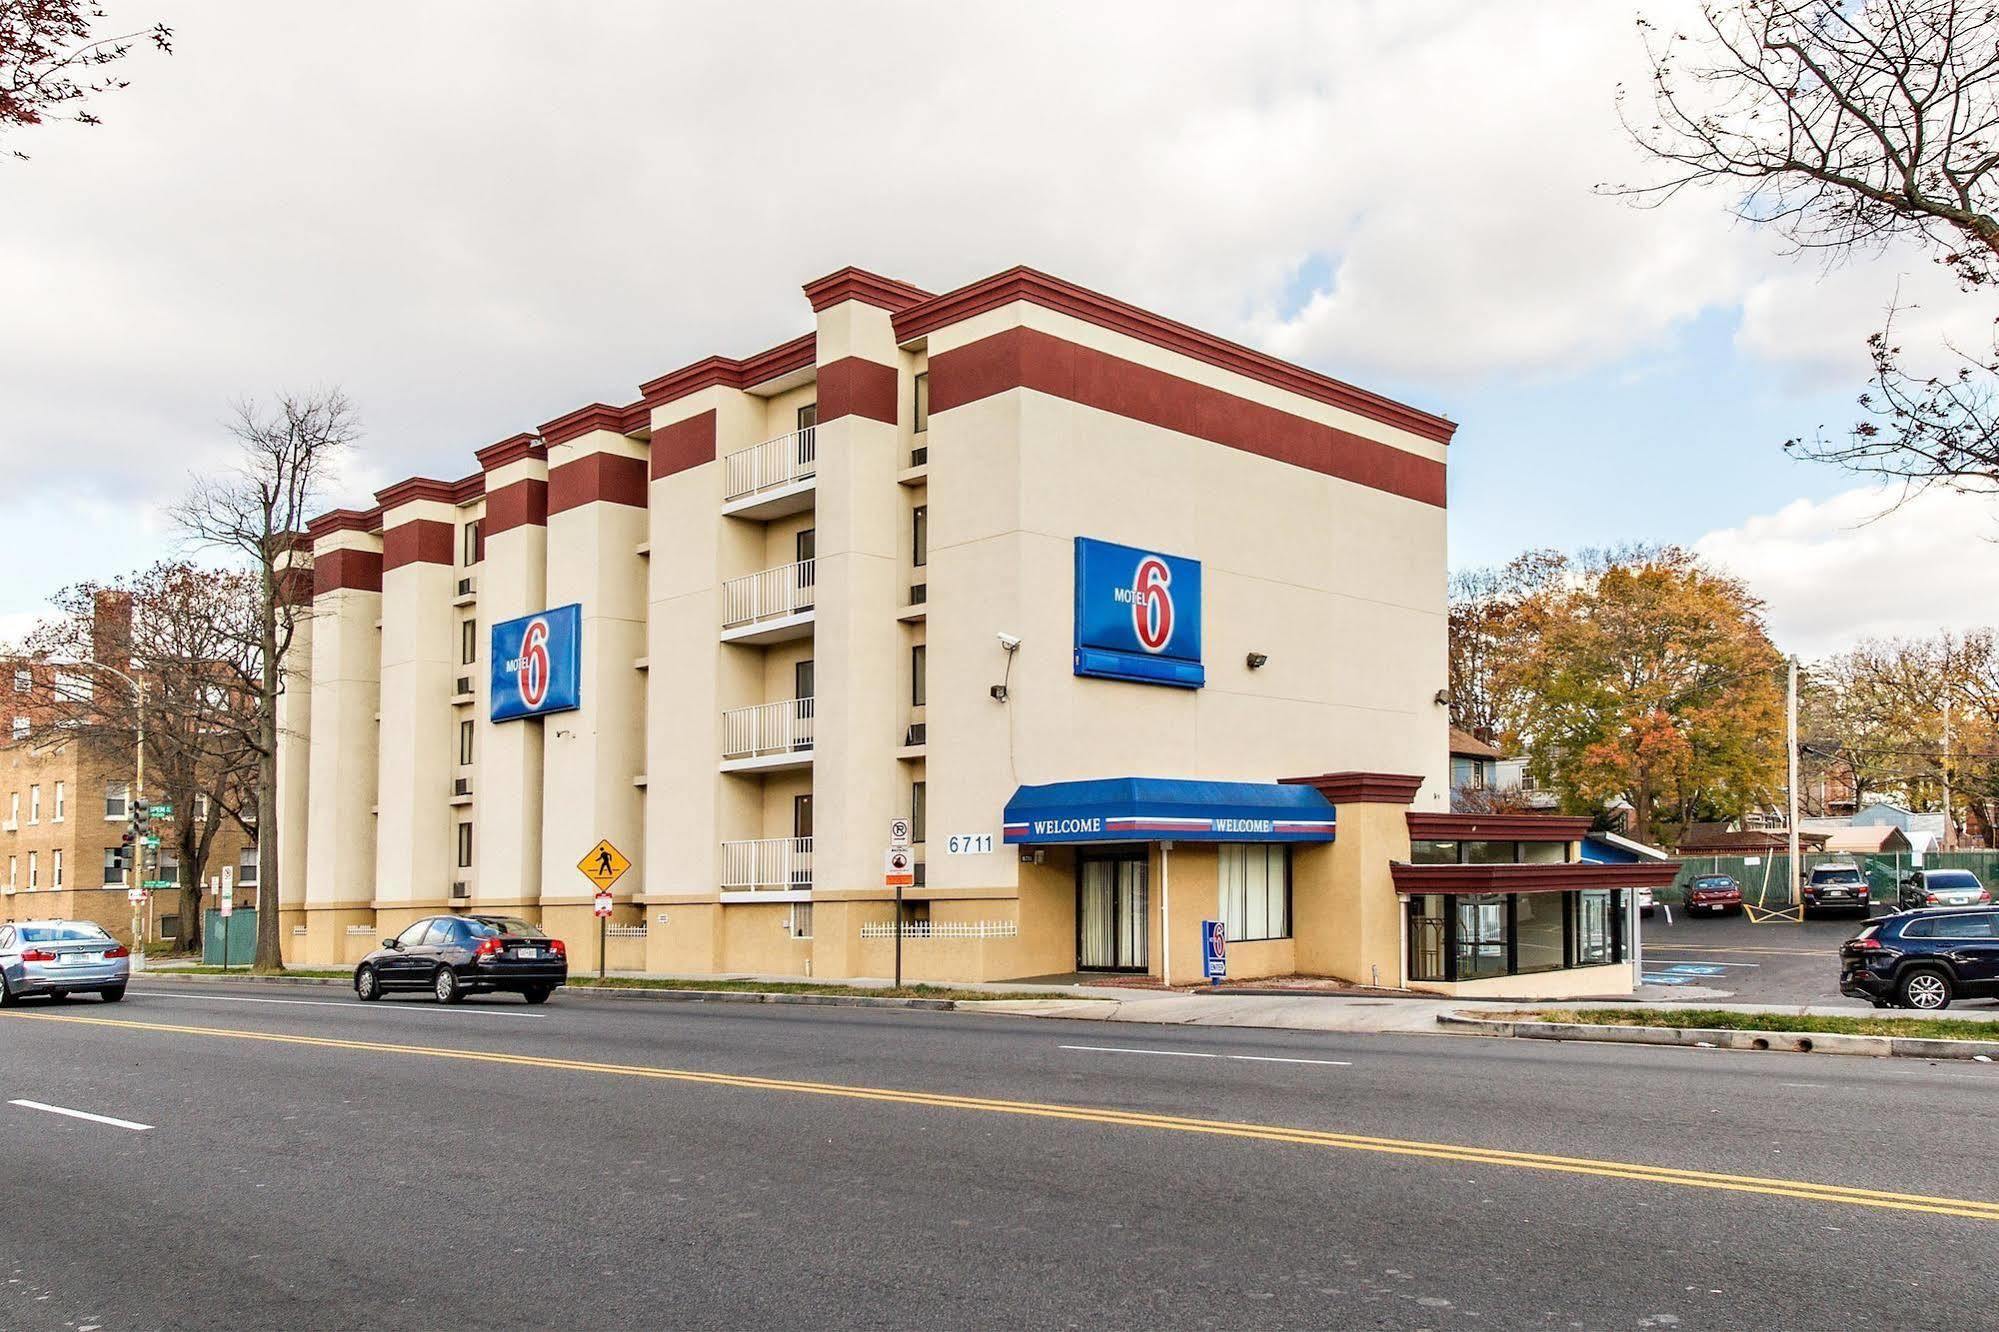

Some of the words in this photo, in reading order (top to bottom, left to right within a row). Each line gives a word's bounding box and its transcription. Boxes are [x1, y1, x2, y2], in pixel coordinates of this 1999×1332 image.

[1114, 587, 1148, 607] MOTEL
[1132, 557, 1173, 652] 6
[506, 656, 530, 673] MOTEL
[519, 619, 549, 708] 6
[1034, 818, 1101, 835] WELCOME
[1216, 819, 1270, 832] WELCOME
[949, 835, 991, 853] 6711
[1213, 922, 1225, 958] 6
